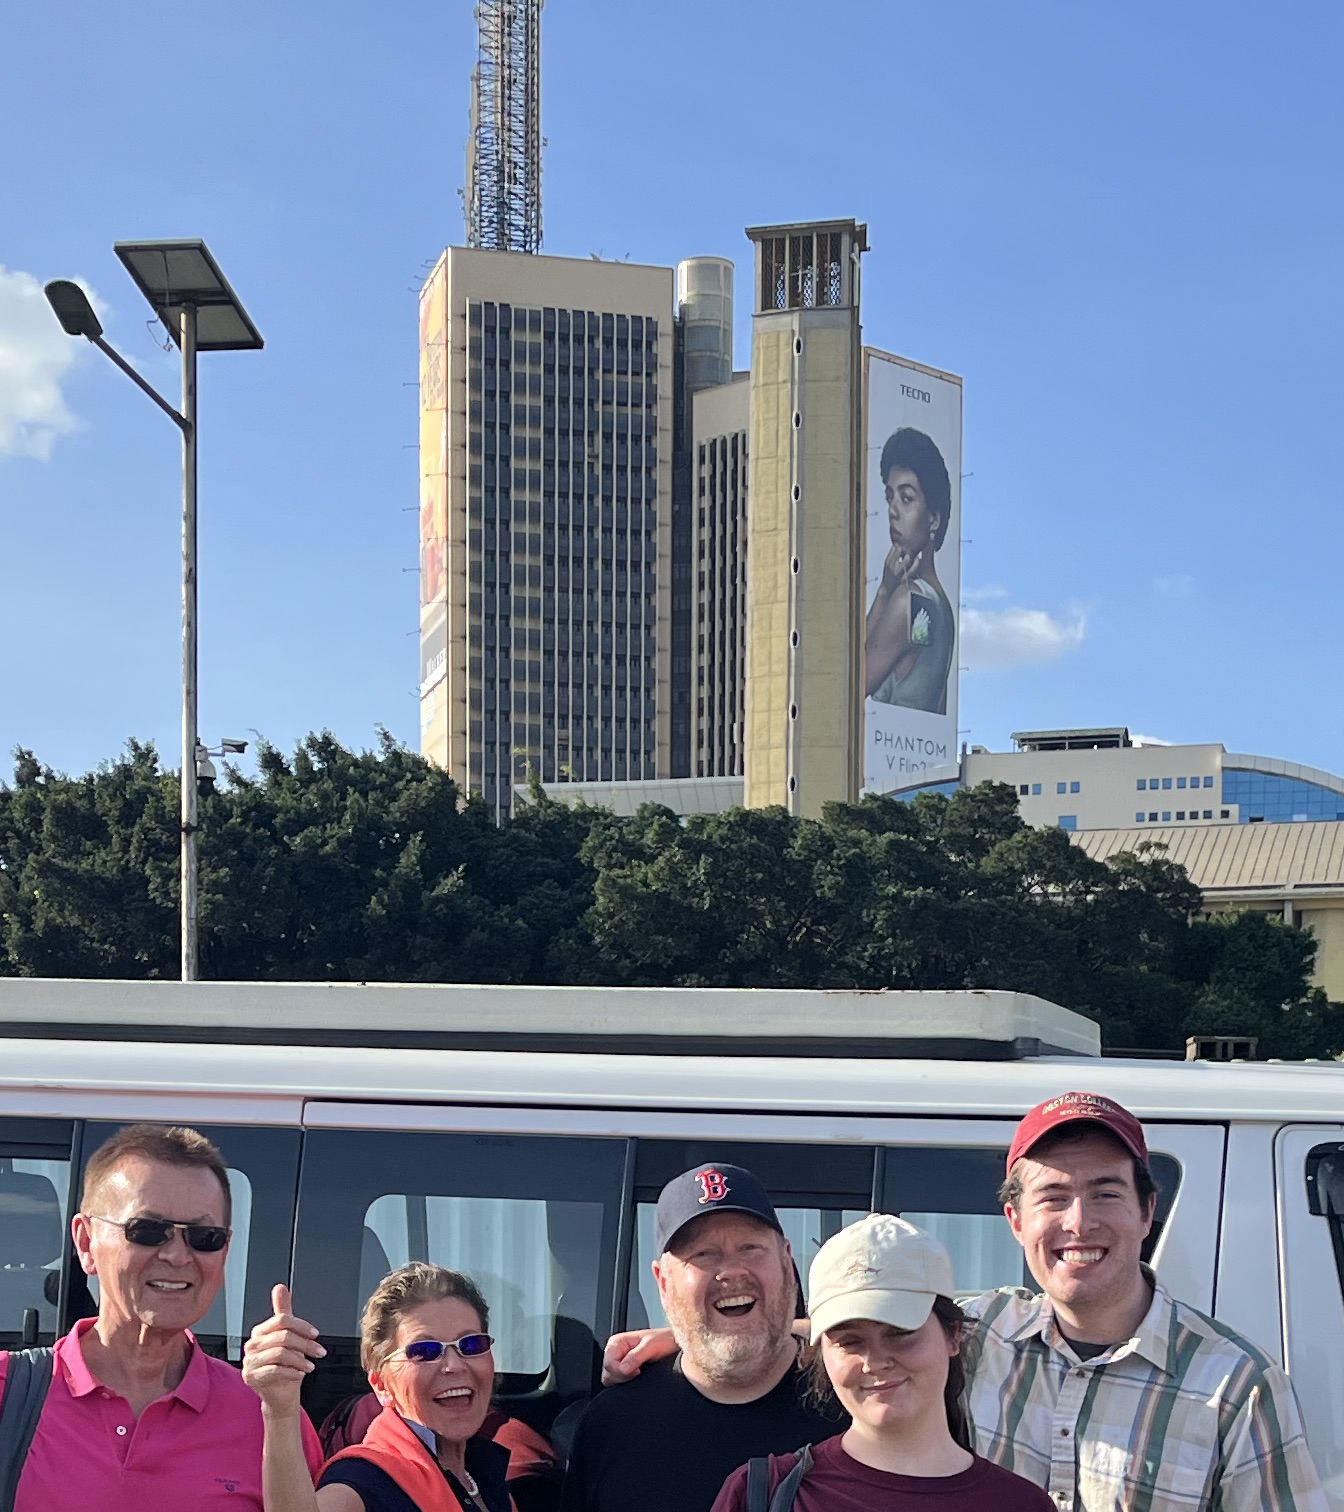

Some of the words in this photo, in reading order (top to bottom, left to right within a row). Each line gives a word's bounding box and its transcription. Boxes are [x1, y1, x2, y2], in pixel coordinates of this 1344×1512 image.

[899, 383, 931, 404] TECNO
[874, 729, 947, 758] PHANTOM
[885, 754, 896, 770] V
[694, 1168, 732, 1204] B
